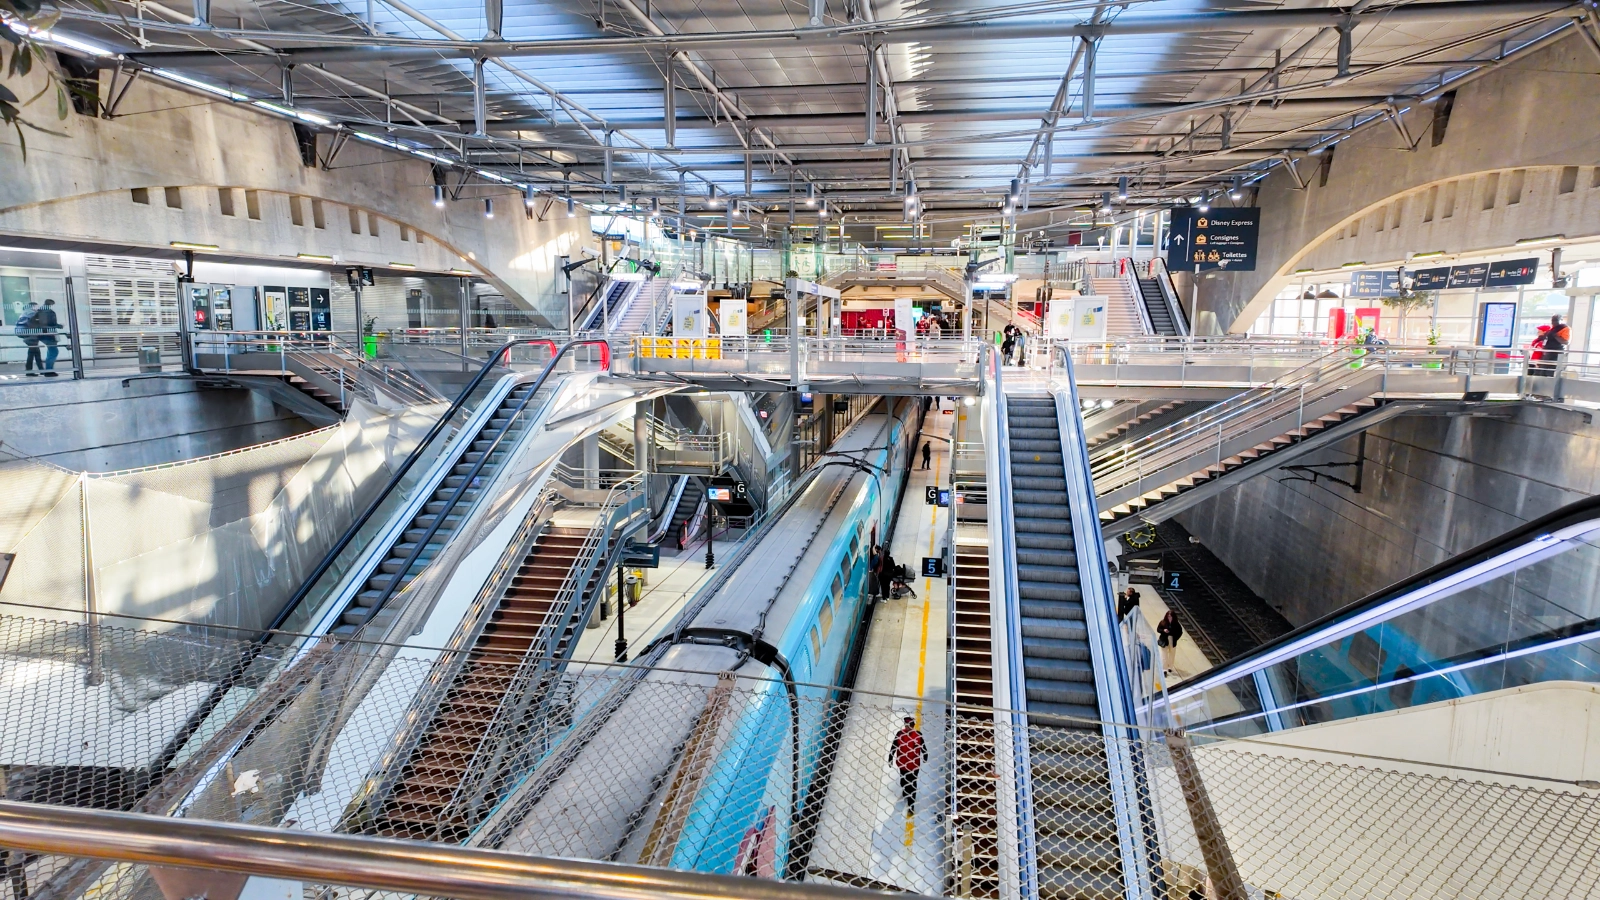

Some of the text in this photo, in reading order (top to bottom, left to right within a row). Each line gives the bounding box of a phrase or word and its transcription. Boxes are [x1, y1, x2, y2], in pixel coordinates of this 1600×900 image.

[1210, 234, 1239, 242] Consignes
[737, 483, 745, 493] G
[928, 489, 936, 499] G
[928, 563, 936, 574] 5
[1170, 577, 1179, 588] 4
